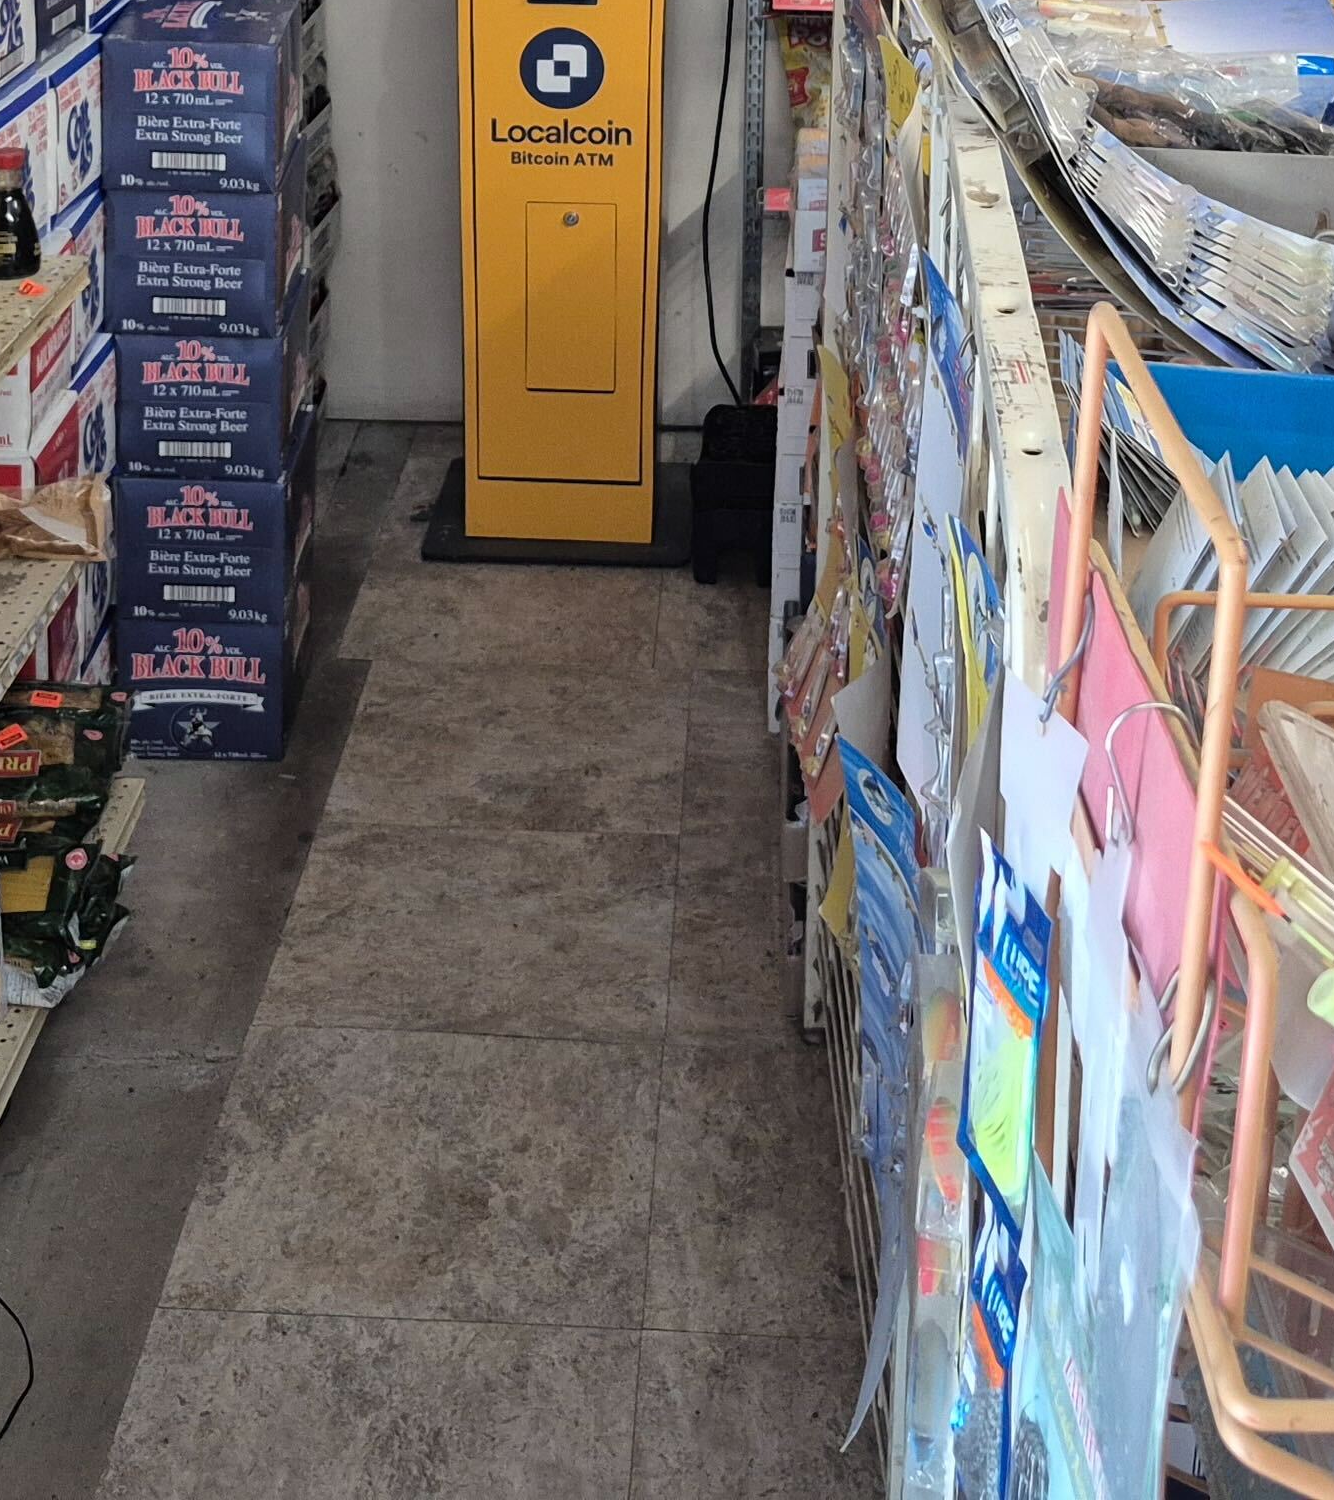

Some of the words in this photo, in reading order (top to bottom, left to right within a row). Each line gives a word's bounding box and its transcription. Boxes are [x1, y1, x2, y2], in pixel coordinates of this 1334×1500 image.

[133, 68, 195, 92] BLACK
[198, 70, 244, 95] BULL
[137, 115, 169, 128] Bière
[172, 116, 242, 131] Extra-Forte
[490, 118, 632, 147] Localcoin
[135, 129, 169, 141] Extra
[171, 130, 211, 145] Strong
[214, 132, 243, 145] Beer
[510, 151, 569, 166] Bitcoin
[574, 152, 614, 166] ATM
[136, 215, 195, 240] BLACK
[199, 217, 244, 241] BULL
[139, 261, 170, 274] Bière
[173, 262, 241, 276] Extra-Forte
[137, 276, 169, 287] Extra
[172, 277, 211, 291] Strong
[214, 278, 243, 289] Beer
[175, 340, 216, 362] 10%
[142, 362, 201, 386] BLACK
[204, 363, 250, 386] BULL
[147, 507, 204, 529] BLACK
[209, 508, 253, 530] BULL
[173, 628, 221, 655] 10%
[132, 653, 205, 680] BLACK
[210, 655, 266, 683] BULL
